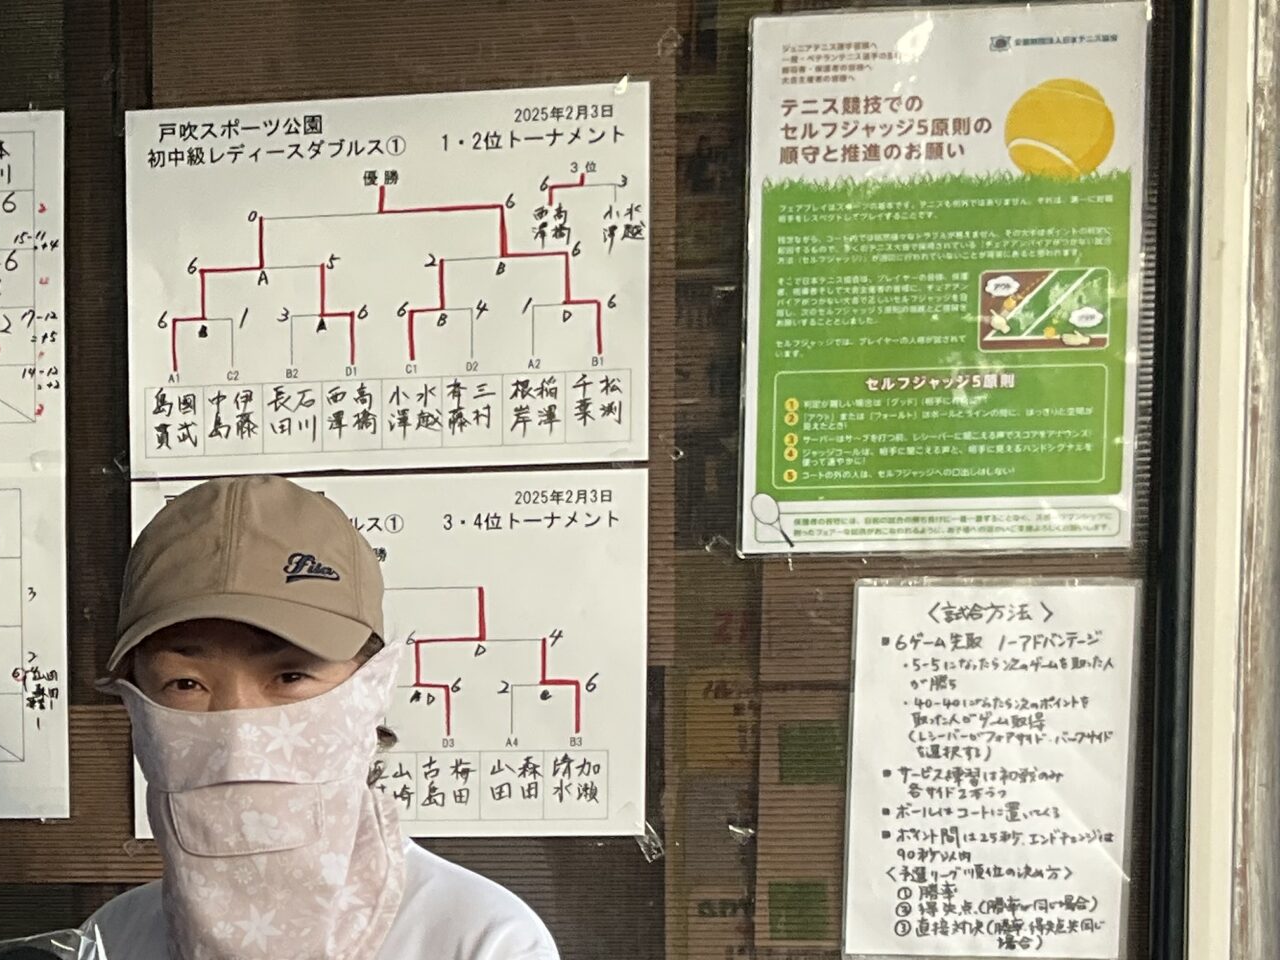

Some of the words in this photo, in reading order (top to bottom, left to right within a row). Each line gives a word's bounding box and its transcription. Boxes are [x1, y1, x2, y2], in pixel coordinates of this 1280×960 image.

[781, 96, 923, 116] テニス競技での
[515, 105, 613, 122] 2025年2月3日
[159, 115, 324, 144] 戸吹スポーツ公園
[780, 118, 992, 140] セルフジャッジ5原則の
[148, 135, 407, 168] 初中級レディースダブルス①
[779, 142, 965, 165] 順守と推進のお願い
[363, 170, 398, 186] 優勝
[506, 193, 515, 208] 6
[188, 257, 197, 274] 6
[327, 254, 340, 269] 5
[425, 254, 437, 267] 2
[608, 294, 616, 308] 6
[277, 309, 289, 322] 3
[358, 305, 368, 319] 6
[397, 303, 408, 317] 6
[158, 312, 167, 328] 6
[466, 361, 478, 371] D2
[528, 359, 540, 369] A2
[592, 357, 603, 366] B1
[227, 371, 239, 381] C2
[286, 369, 298, 378] B2
[346, 367, 356, 376] D1
[406, 364, 416, 374] C1
[169, 374, 179, 382] A1
[865, 374, 1015, 391] セルフジャッジ5原則
[515, 489, 612, 504] 2025年2月3日
[498, 681, 509, 693] 2
[586, 673, 598, 692] 6
[442, 738, 454, 748] D3
[506, 738, 518, 746] A4
[570, 737, 582, 746] B3
